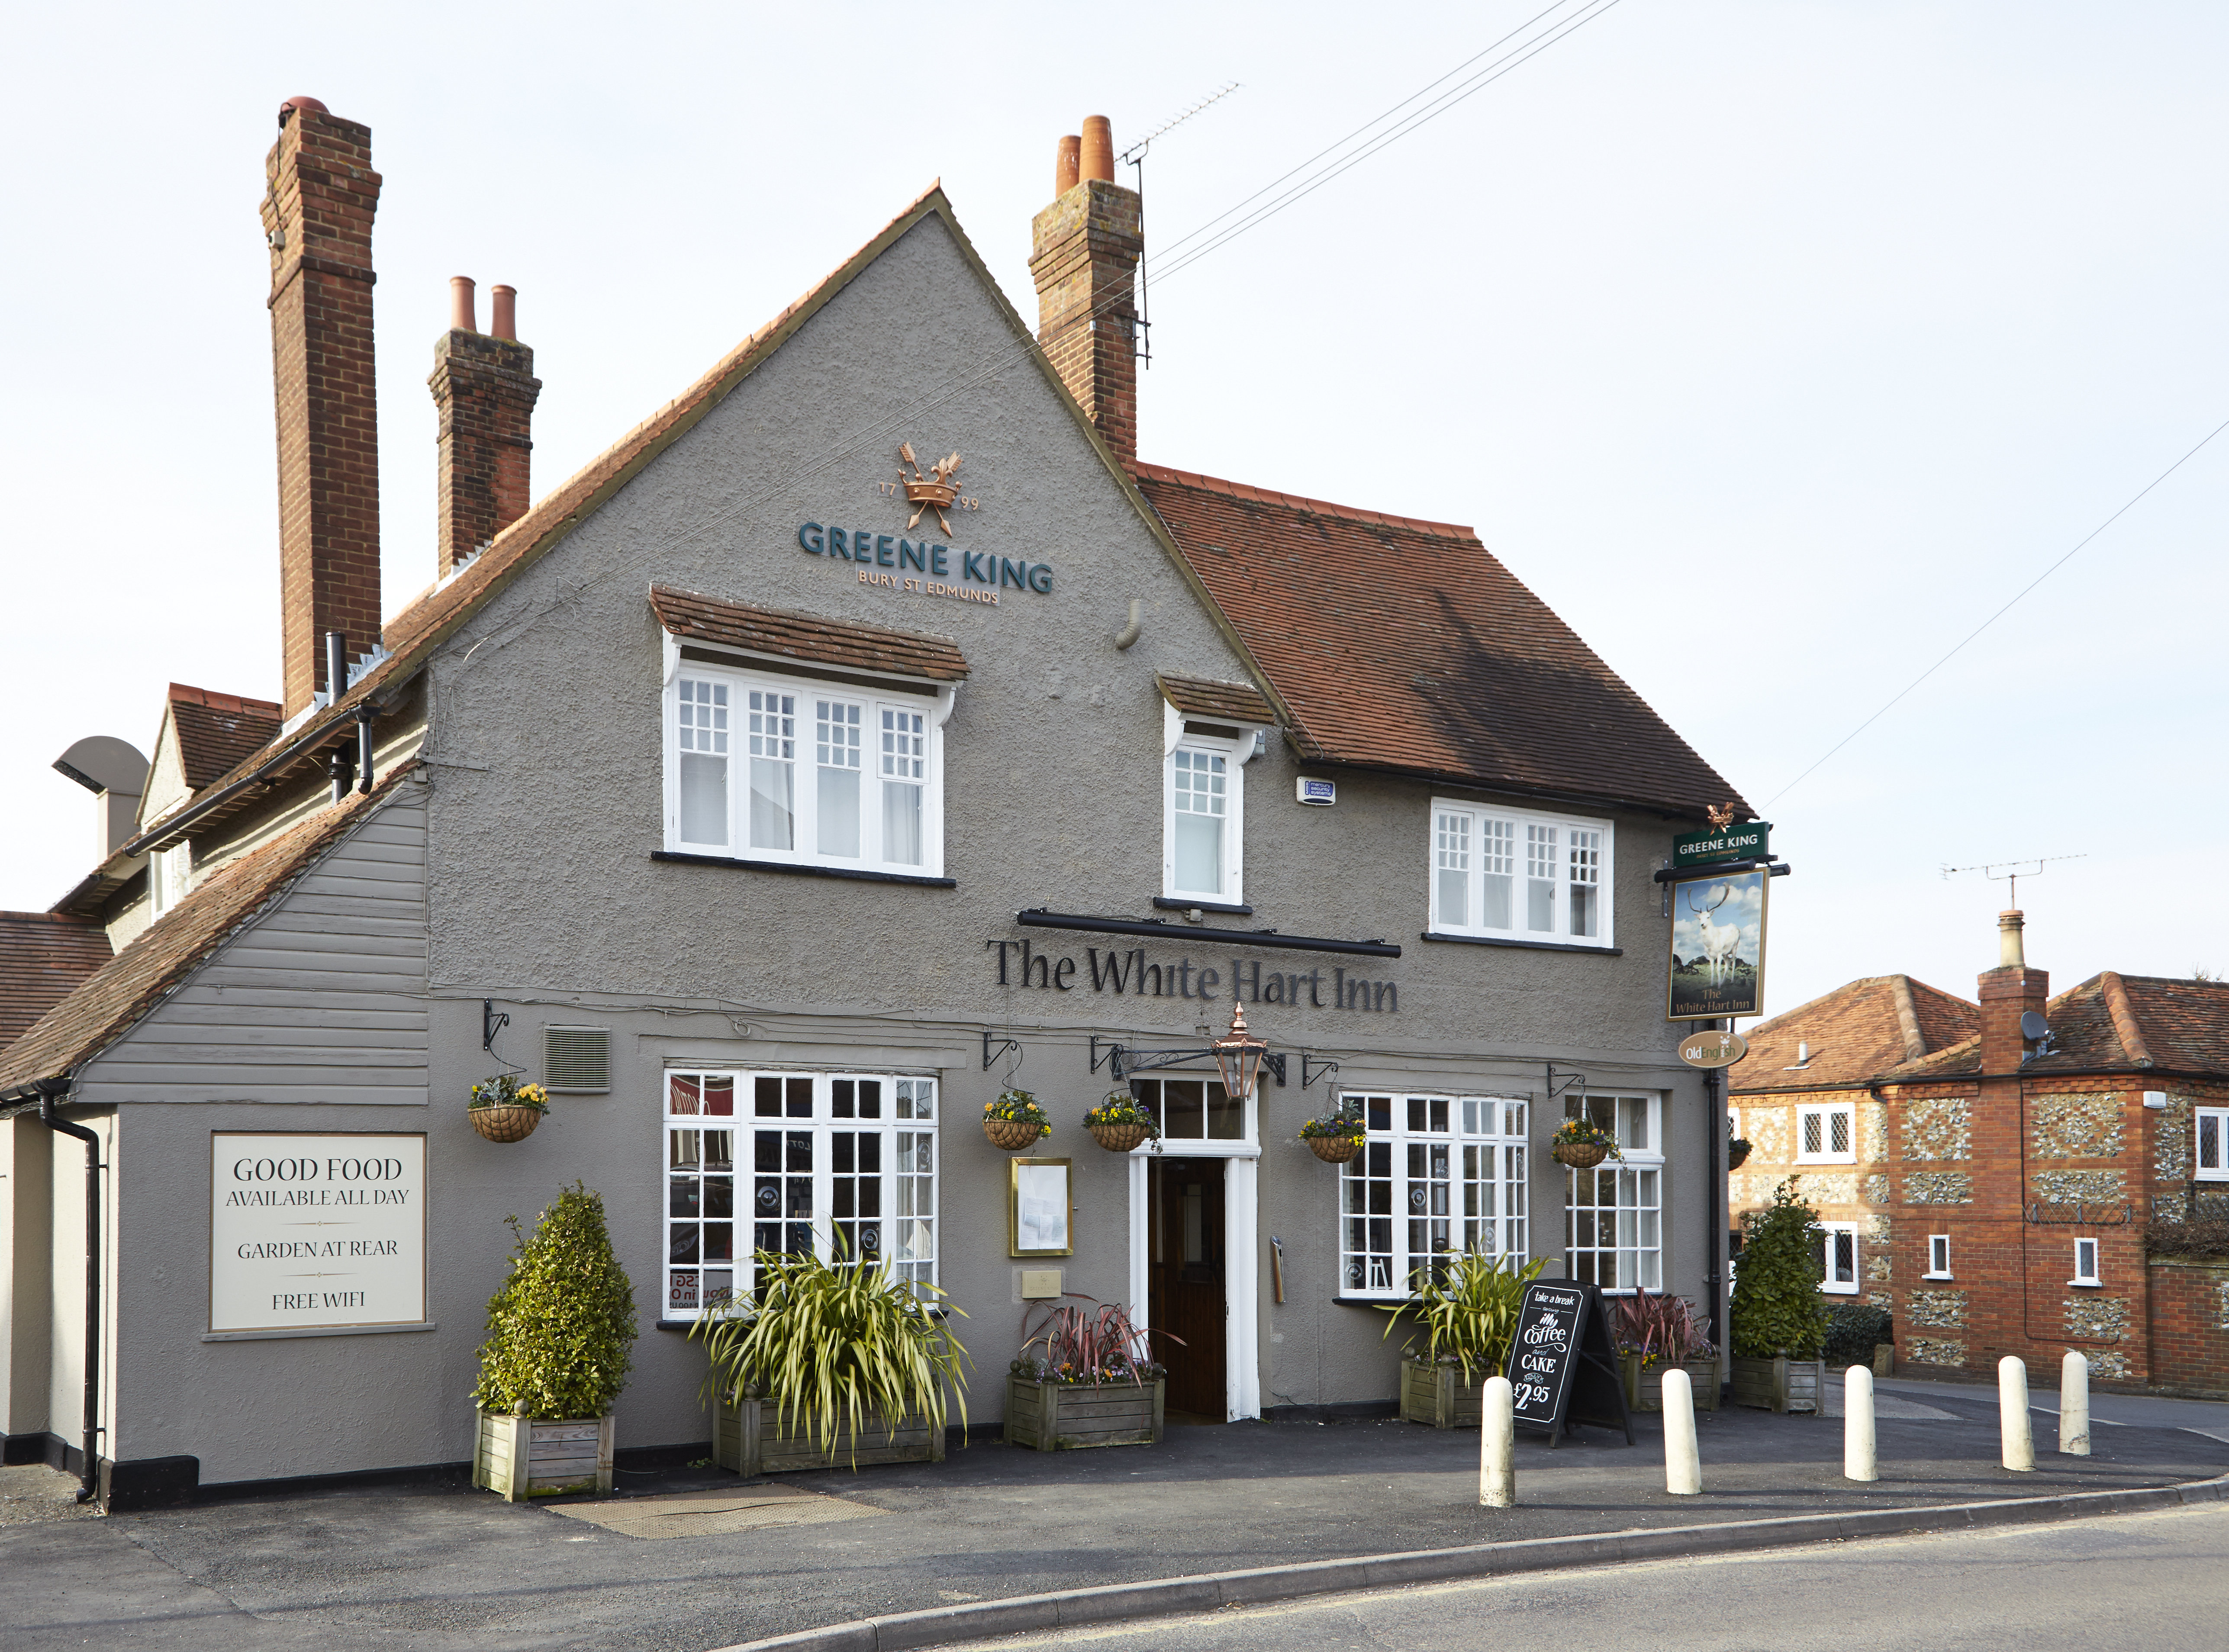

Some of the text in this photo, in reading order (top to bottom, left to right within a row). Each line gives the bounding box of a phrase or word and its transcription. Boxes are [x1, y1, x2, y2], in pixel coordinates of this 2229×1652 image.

[880, 482, 979, 511] 17 99
[799, 522, 1052, 593] GREENE KING
[858, 570, 999, 604] BURY ST EDMUNDS
[1679, 834, 1758, 854] GREENE KING
[987, 939, 1400, 1012] The White Hart Inn
[1702, 989, 1721, 999] The
[1676, 1000, 1749, 1013] White Hart Inn
[234, 1159, 402, 1181] GOOD FOOD
[225, 1189, 409, 1206] AVAILABLE ALL DAY
[238, 1240, 398, 1259] GARDEN AT REAR
[272, 1291, 365, 1310] FREE WIFI
[1534, 1291, 1549, 1302] take
[1555, 1295, 1575, 1305] break
[1539, 1313, 1558, 1329] illy
[1521, 1354, 1556, 1373] CAKE
[1513, 1383, 1550, 1410] £2.95
